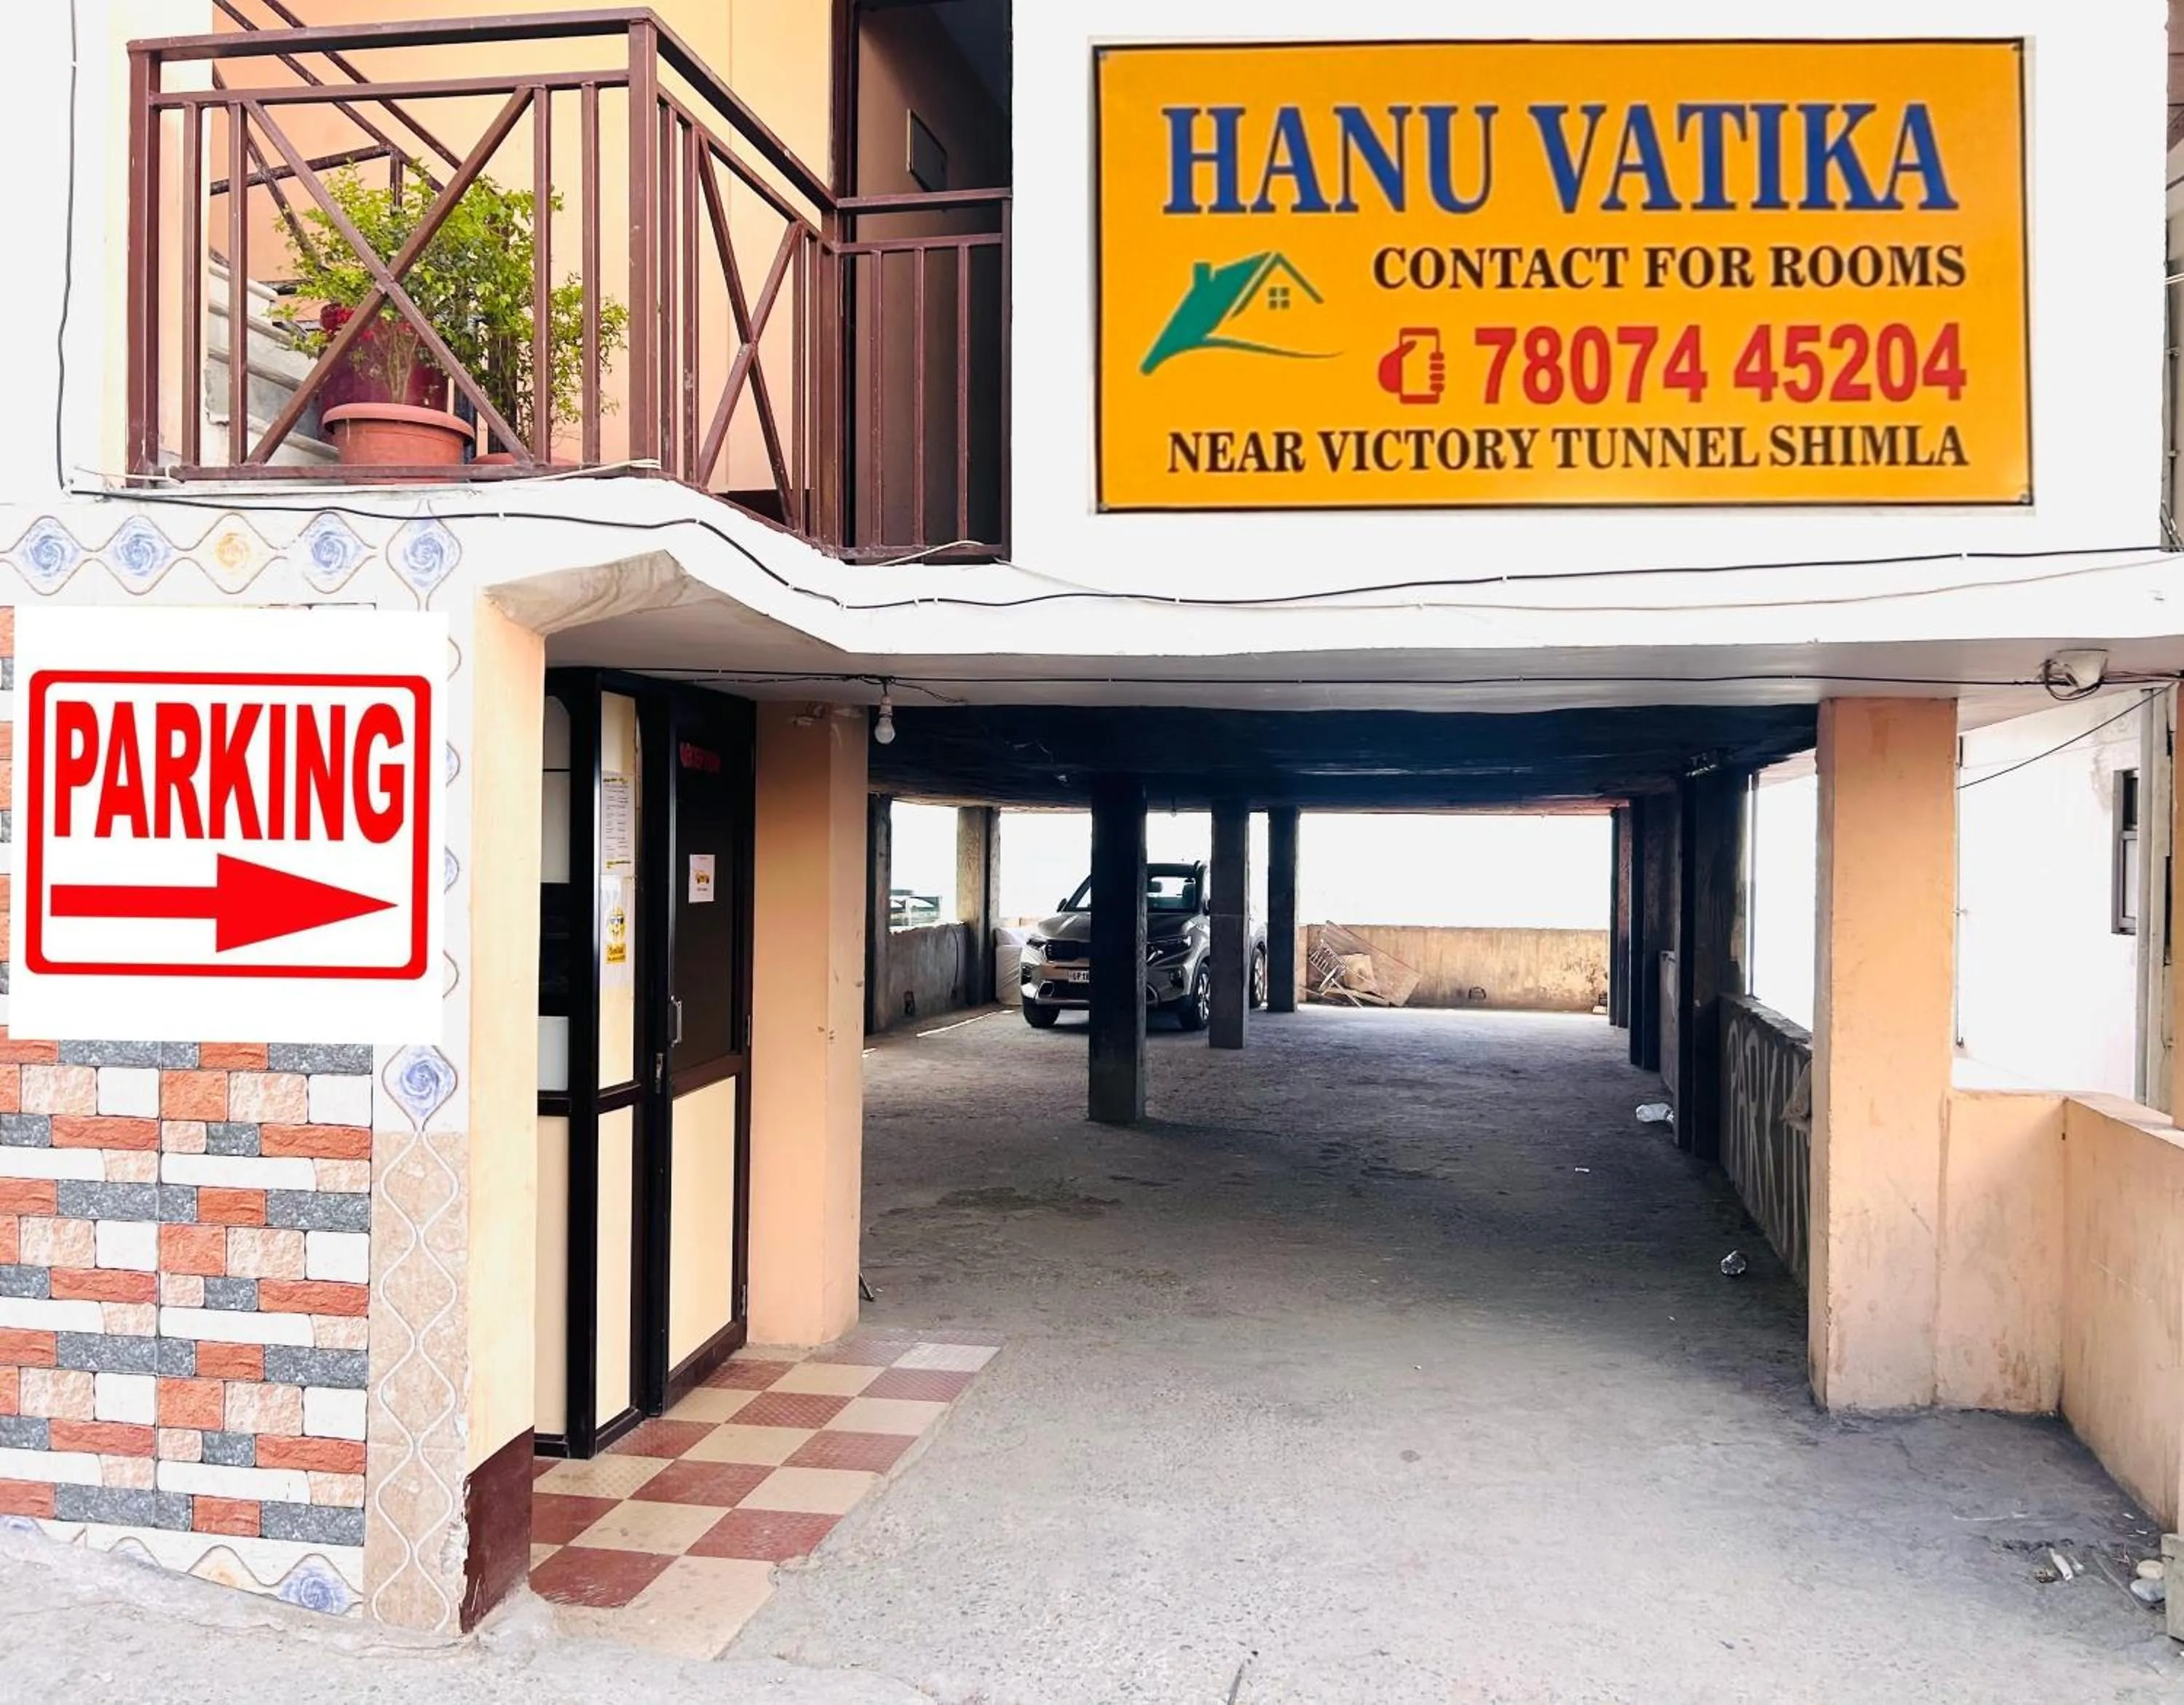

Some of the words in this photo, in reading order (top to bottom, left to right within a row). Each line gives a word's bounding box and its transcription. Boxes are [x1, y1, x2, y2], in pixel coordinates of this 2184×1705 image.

[1161, 106, 1498, 215] HANU
[1528, 103, 1959, 213] VATIKA
[1374, 247, 1629, 290] CONTACT
[1645, 246, 1754, 289] FOR
[1770, 245, 1966, 288] ROOMS
[1474, 324, 1709, 406] 78074
[1733, 323, 1967, 404] 45204
[1168, 431, 1306, 473] NEAR
[1317, 428, 1539, 472] VICTORY
[1551, 427, 1760, 470] TUNNEL
[1769, 424, 1969, 467] SHIMLA
[54, 700, 405, 844] PARKING
